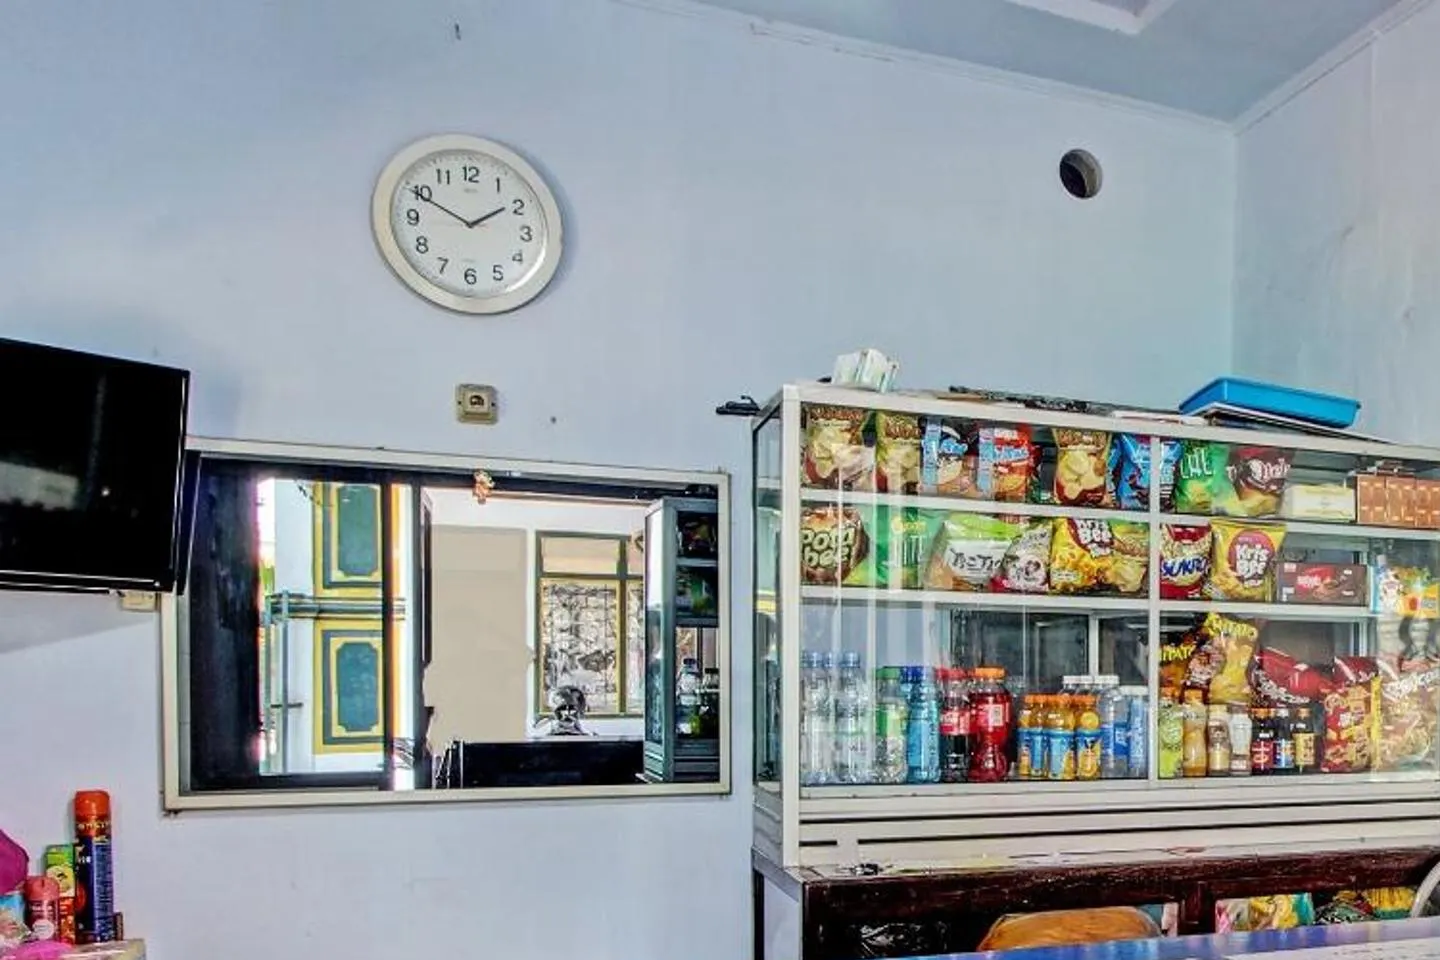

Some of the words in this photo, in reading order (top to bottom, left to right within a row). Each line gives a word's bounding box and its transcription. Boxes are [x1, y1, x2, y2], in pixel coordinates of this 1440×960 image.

[436, 168, 451, 185] 11
[462, 166, 480, 183] 12
[414, 185, 433, 201] 10
[496, 177, 501, 193] 1
[512, 199, 526, 216] 2
[406, 208, 420, 226] 9
[520, 225, 533, 242] 3
[415, 236, 429, 254] 8
[512, 249, 524, 265] 4
[437, 257, 449, 275] 7
[492, 264, 504, 281] 5
[464, 268, 477, 285] 6
